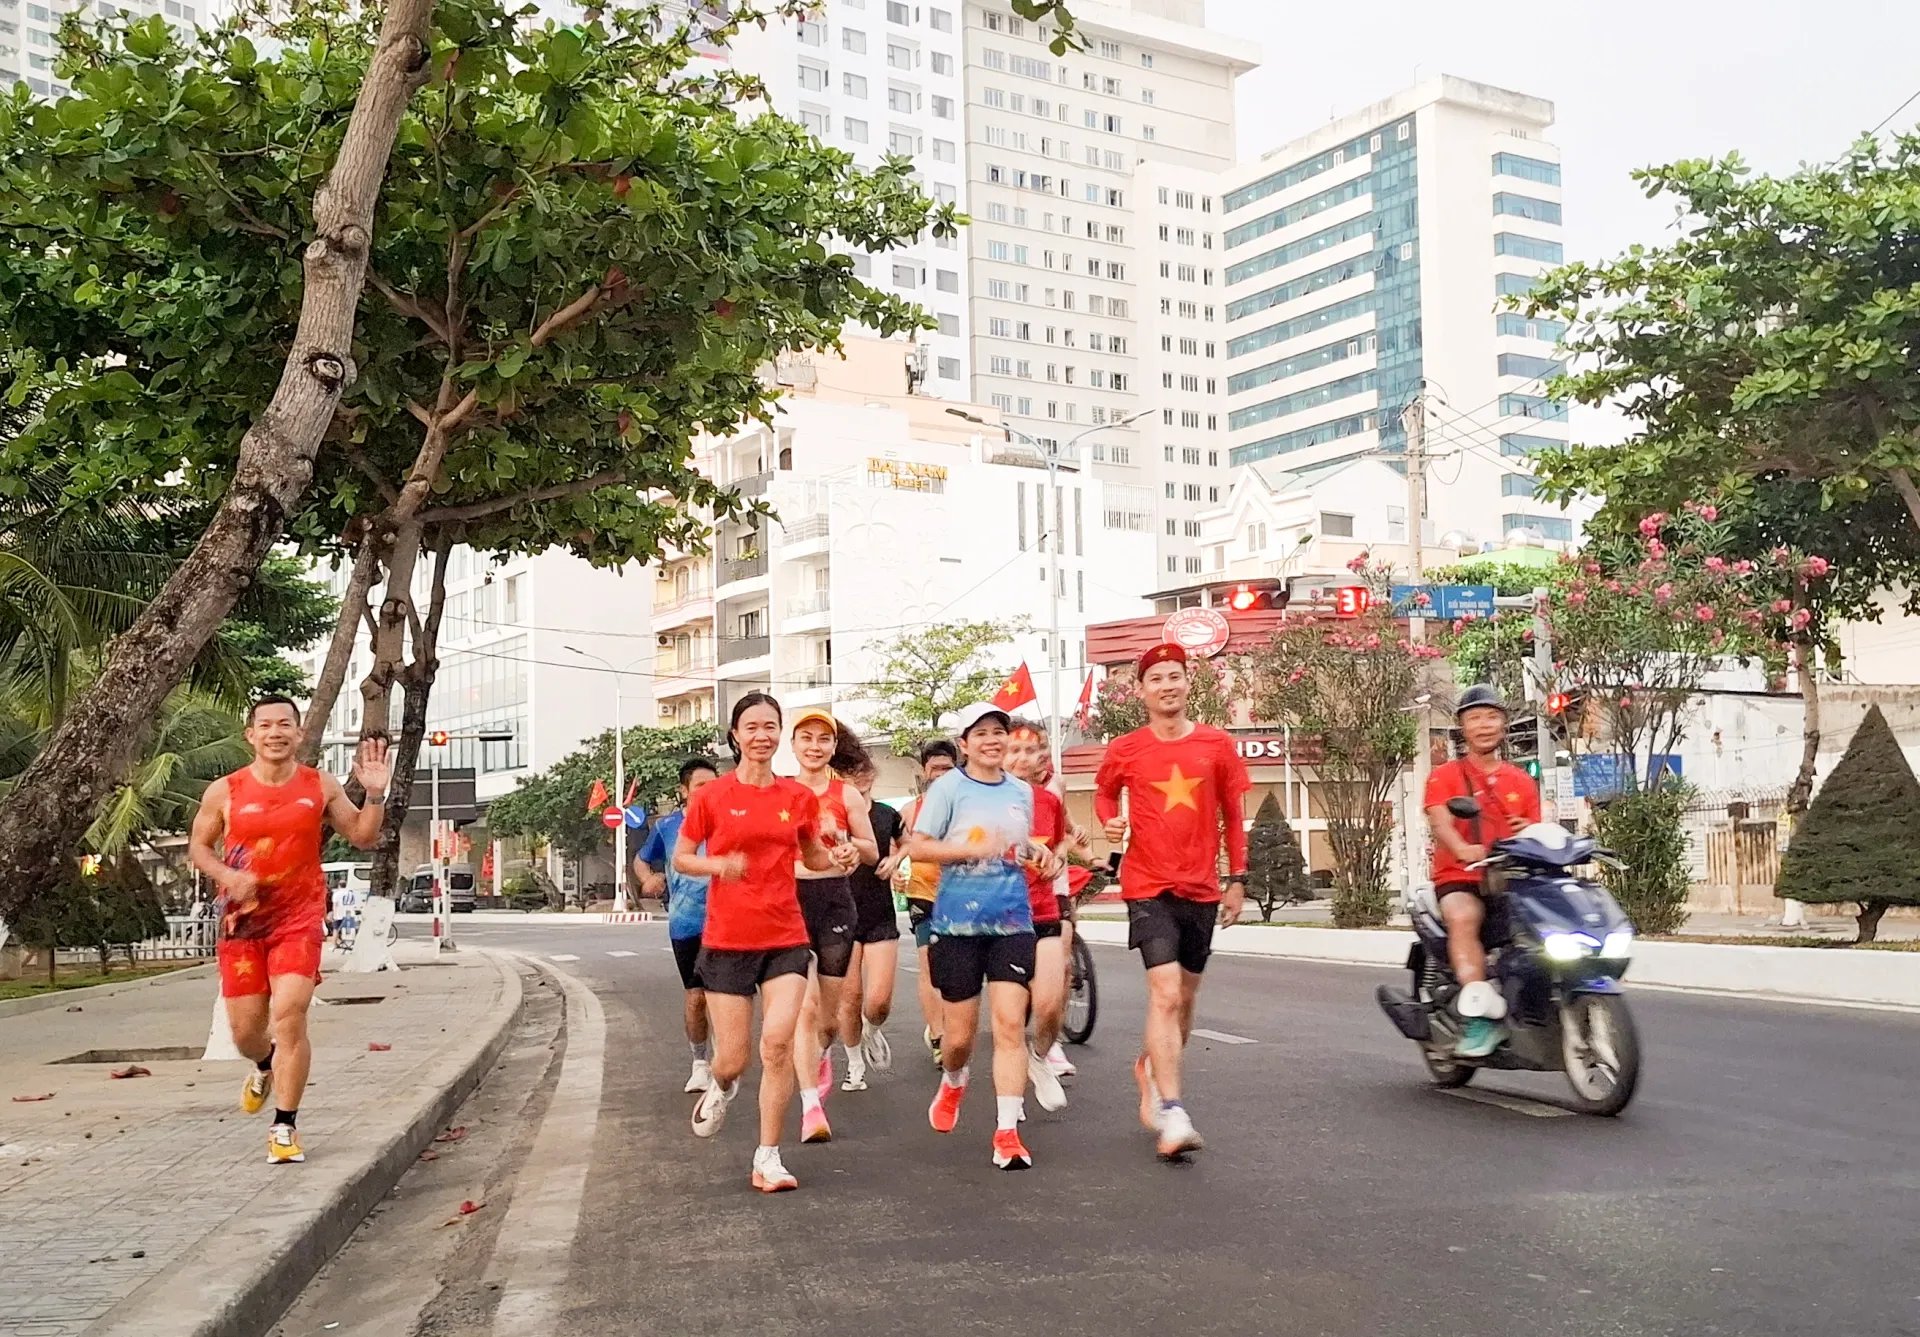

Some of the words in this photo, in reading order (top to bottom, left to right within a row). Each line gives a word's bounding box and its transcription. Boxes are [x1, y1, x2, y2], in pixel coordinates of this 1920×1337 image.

[906, 461, 947, 480] NAM
[1341, 588, 1367, 612] 31
[1166, 609, 1226, 632] HIGHLANDS
